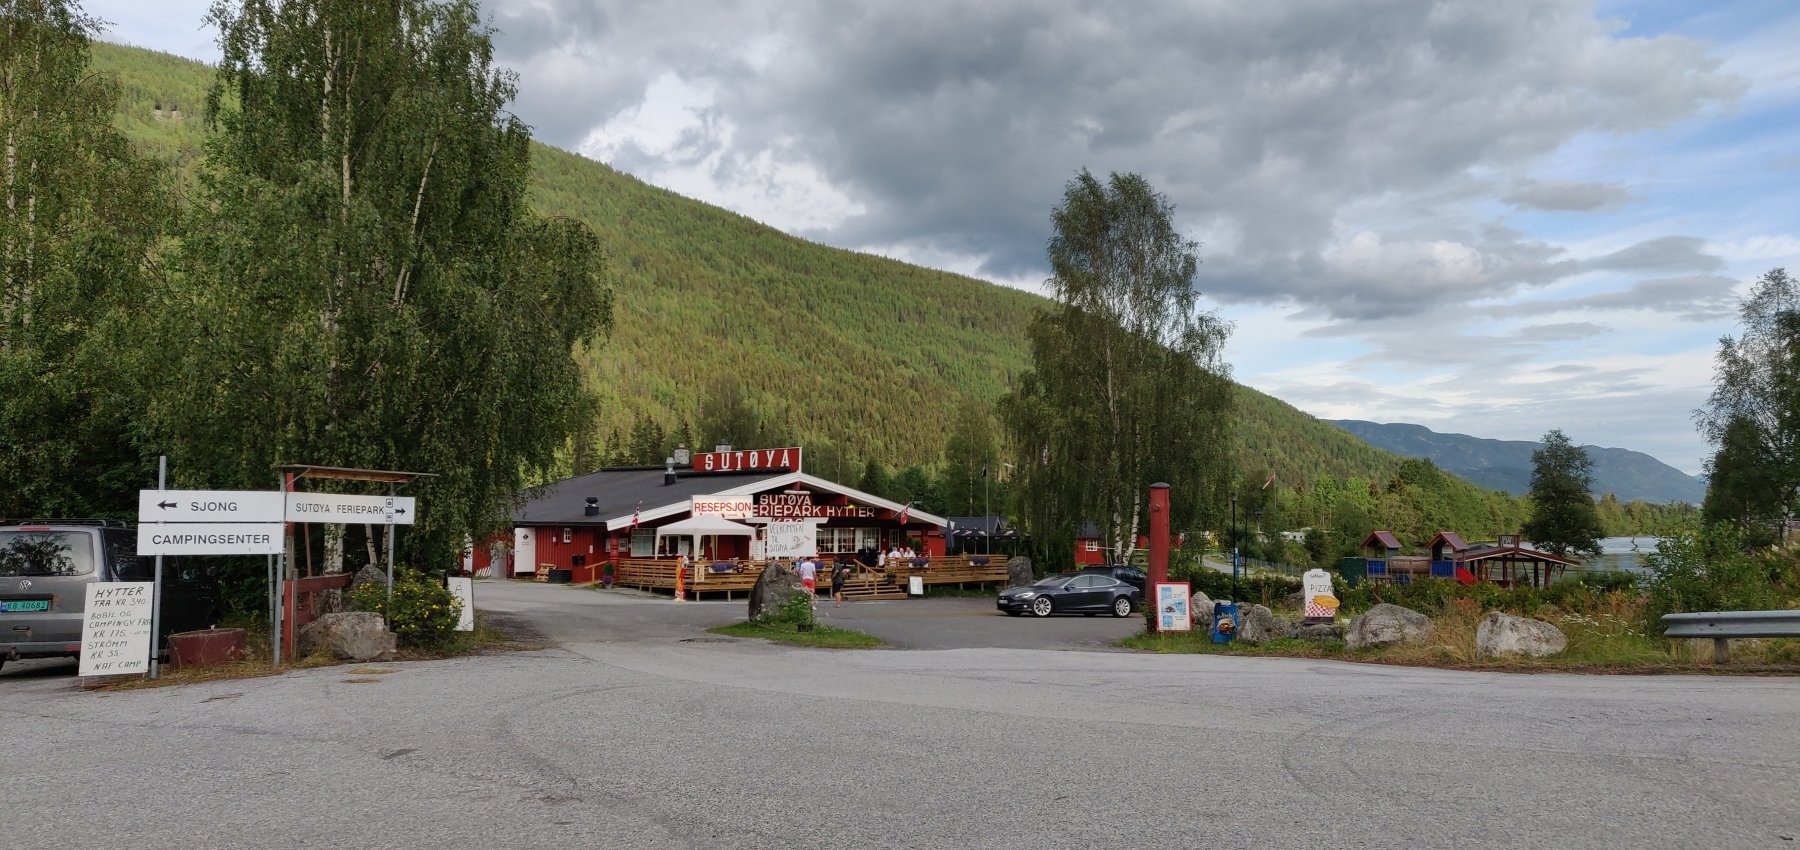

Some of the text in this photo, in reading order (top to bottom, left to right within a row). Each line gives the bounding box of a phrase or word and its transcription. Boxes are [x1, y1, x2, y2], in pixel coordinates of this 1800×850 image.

[705, 449, 790, 471] SUTØYA
[760, 494, 812, 506] SUTØYA
[190, 501, 238, 512] SJONG
[295, 502, 385, 515] SUTØYA FERIEPARK
[694, 502, 752, 512] RESEPSJON
[752, 505, 875, 518] ERIEPARK HYTTER
[152, 534, 270, 545] CAMPINGSENTER
[94, 586, 144, 599] HYTTER
[1310, 583, 1333, 593] PIZZA
[21, 601, 46, 609] 40682
[119, 610, 132, 618] OG
[92, 630, 106, 639] KR
[118, 660, 142, 669] CAMP
